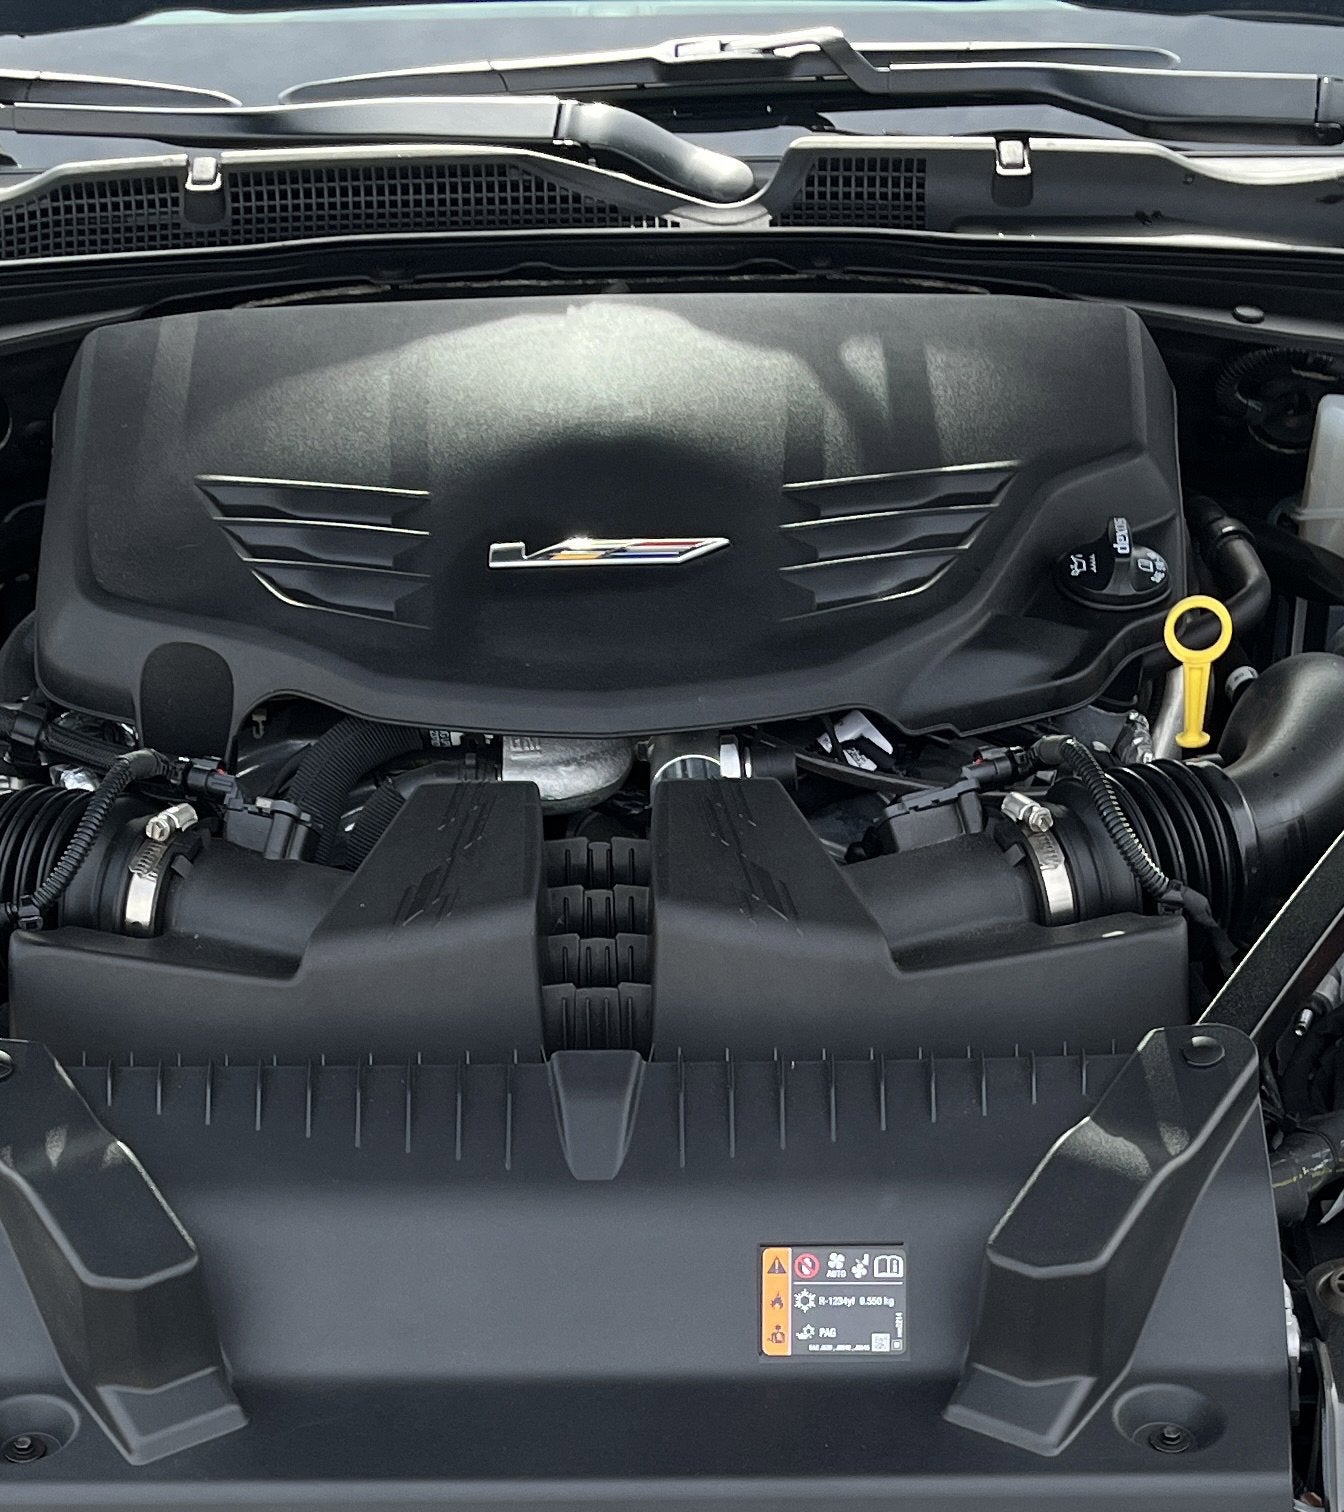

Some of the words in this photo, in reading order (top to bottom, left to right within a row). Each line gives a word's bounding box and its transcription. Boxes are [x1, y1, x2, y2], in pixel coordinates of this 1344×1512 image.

[825, 1269, 847, 1278] AUTO
[818, 1296, 856, 1308] R-1234yf
[884, 1296, 895, 1308] kg
[819, 1327, 837, 1338] PAG
